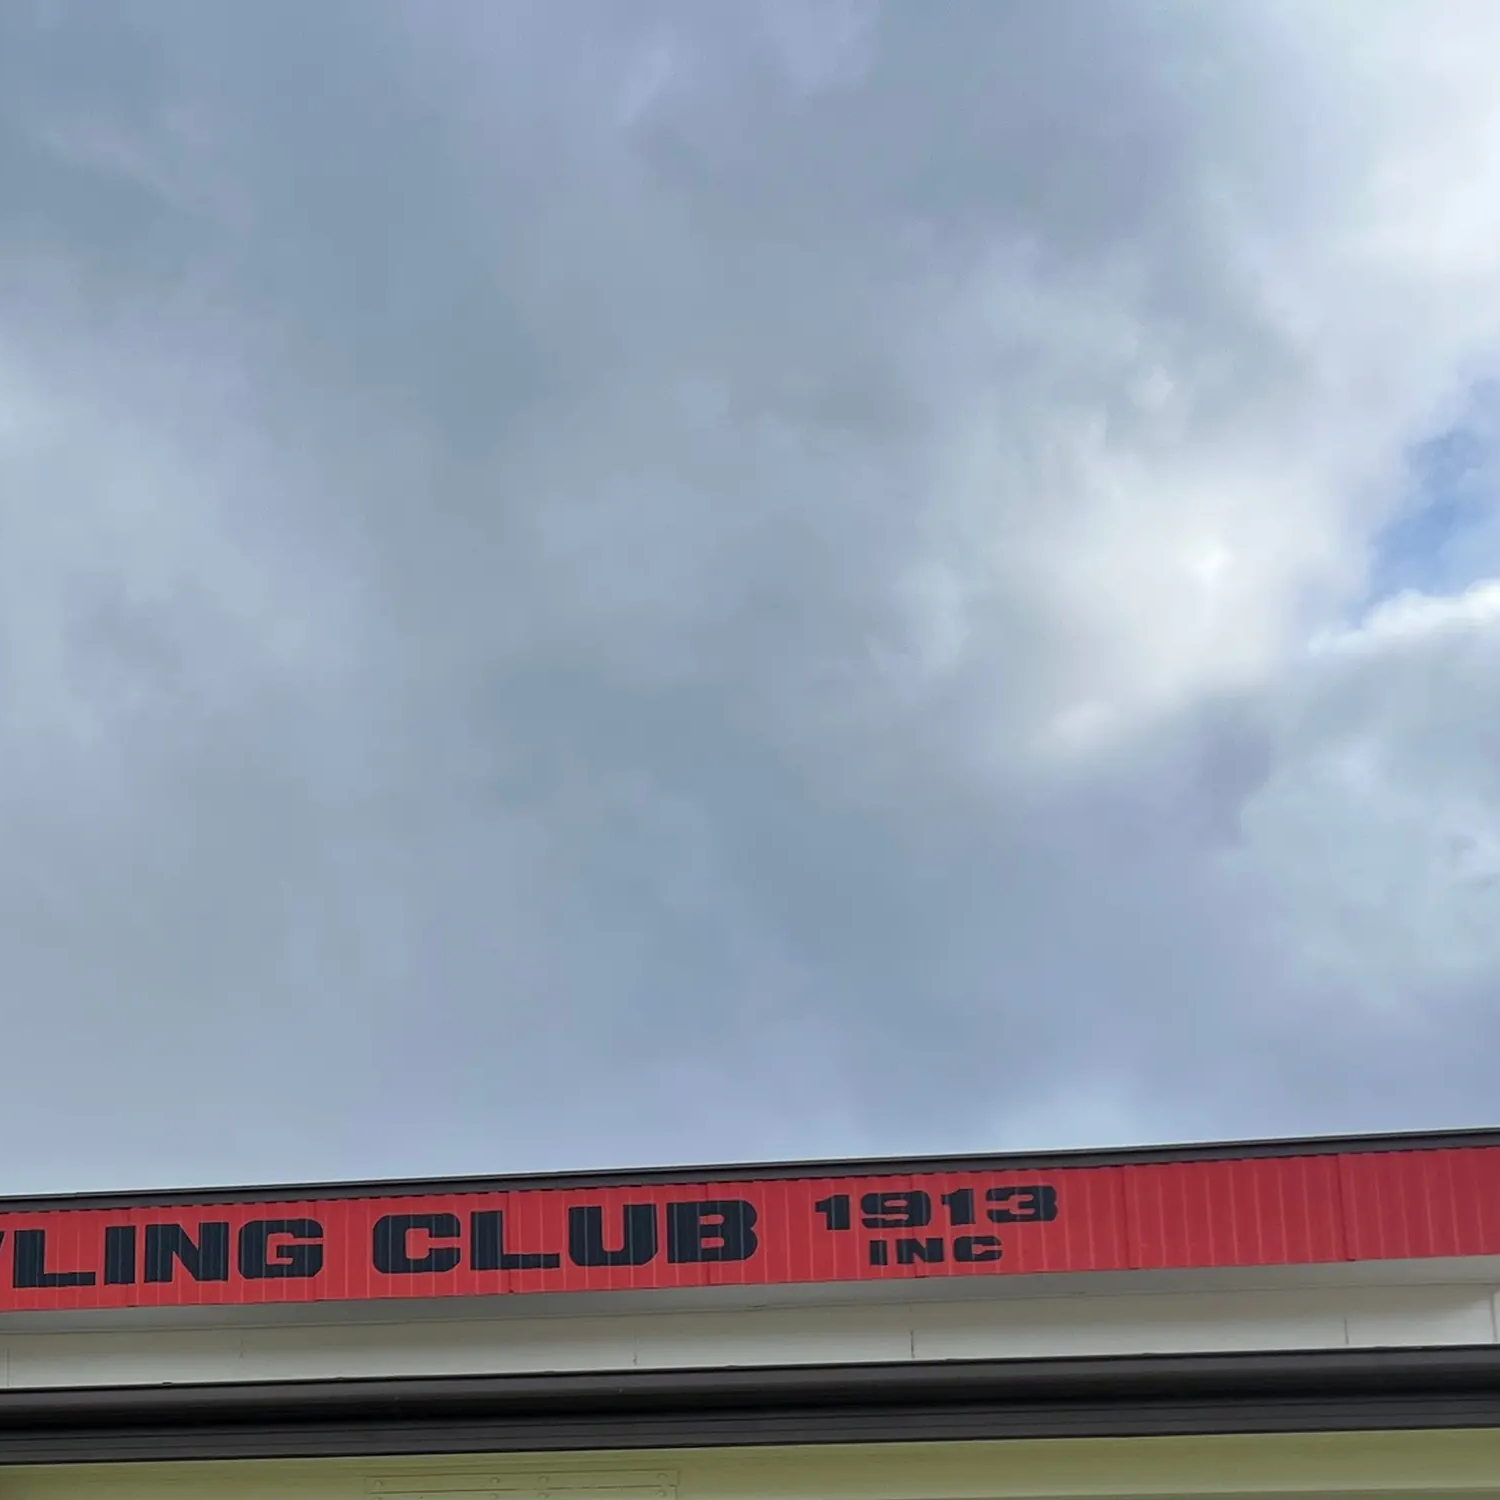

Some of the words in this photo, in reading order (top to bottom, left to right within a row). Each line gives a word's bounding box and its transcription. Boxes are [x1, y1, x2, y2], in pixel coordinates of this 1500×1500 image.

[372, 1200, 759, 1274] CLUB
[815, 1184, 1059, 1231] 1913
[869, 1235, 1003, 1266] INC
